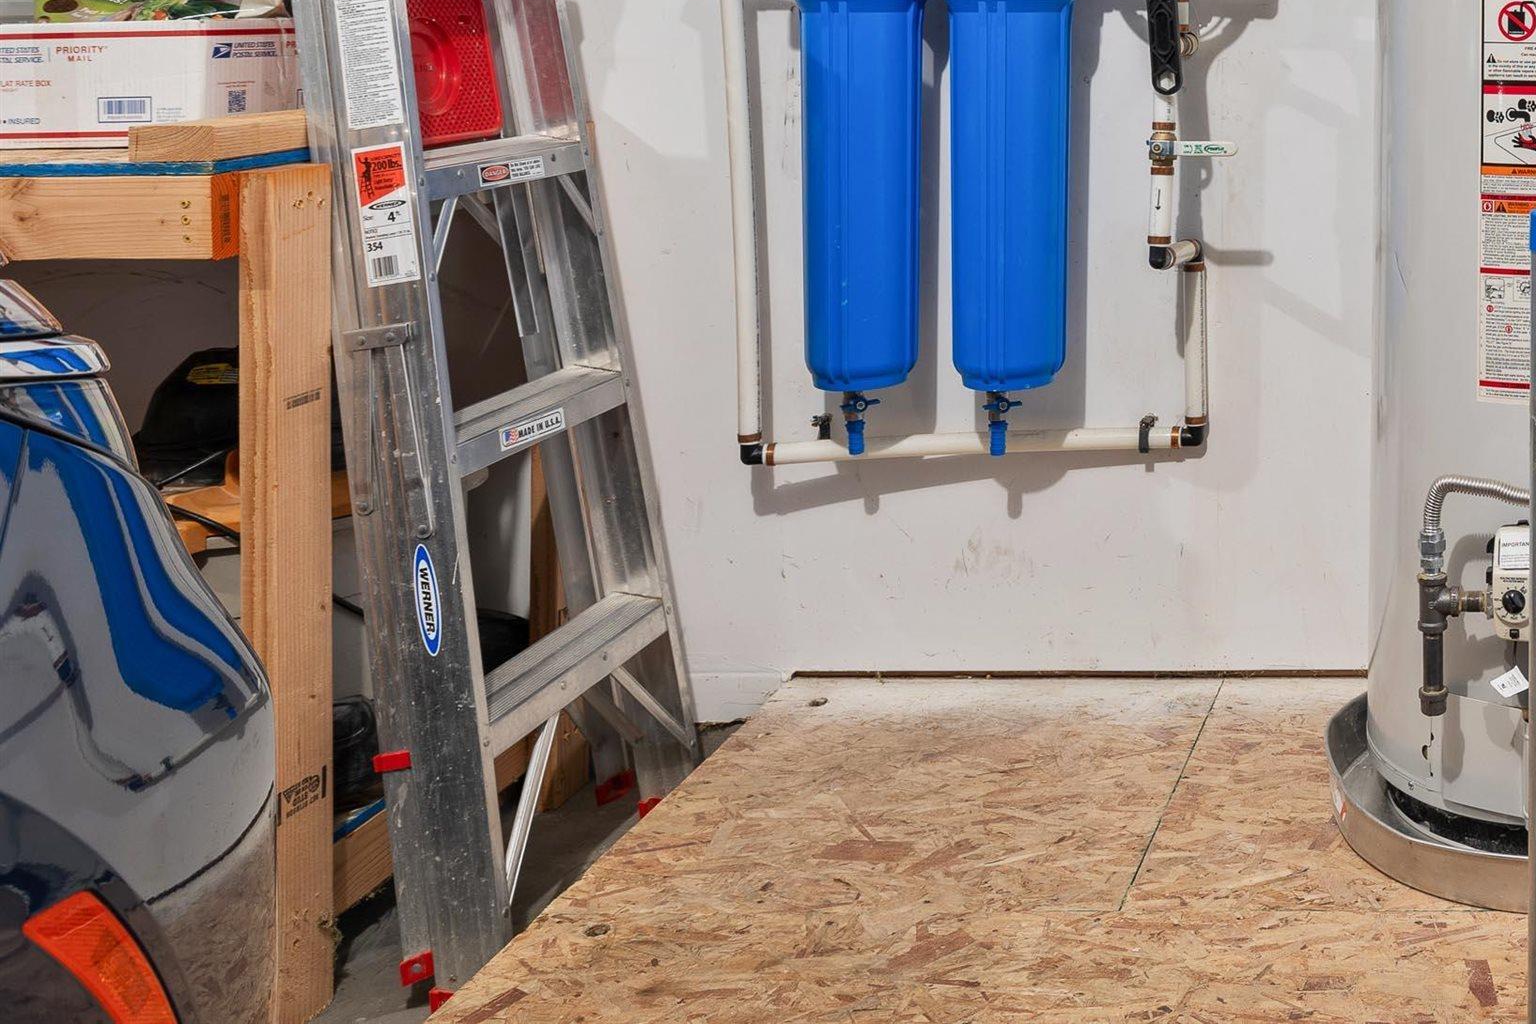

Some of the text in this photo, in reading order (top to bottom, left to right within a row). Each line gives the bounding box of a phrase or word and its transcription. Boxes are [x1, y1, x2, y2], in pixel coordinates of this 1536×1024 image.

[371, 158, 402, 171] 200 lbs.
[387, 212, 396, 222] 4
[367, 242, 383, 252] 354
[518, 416, 561, 437] MADE IN U.S.A.
[419, 567, 436, 634] WERNER
